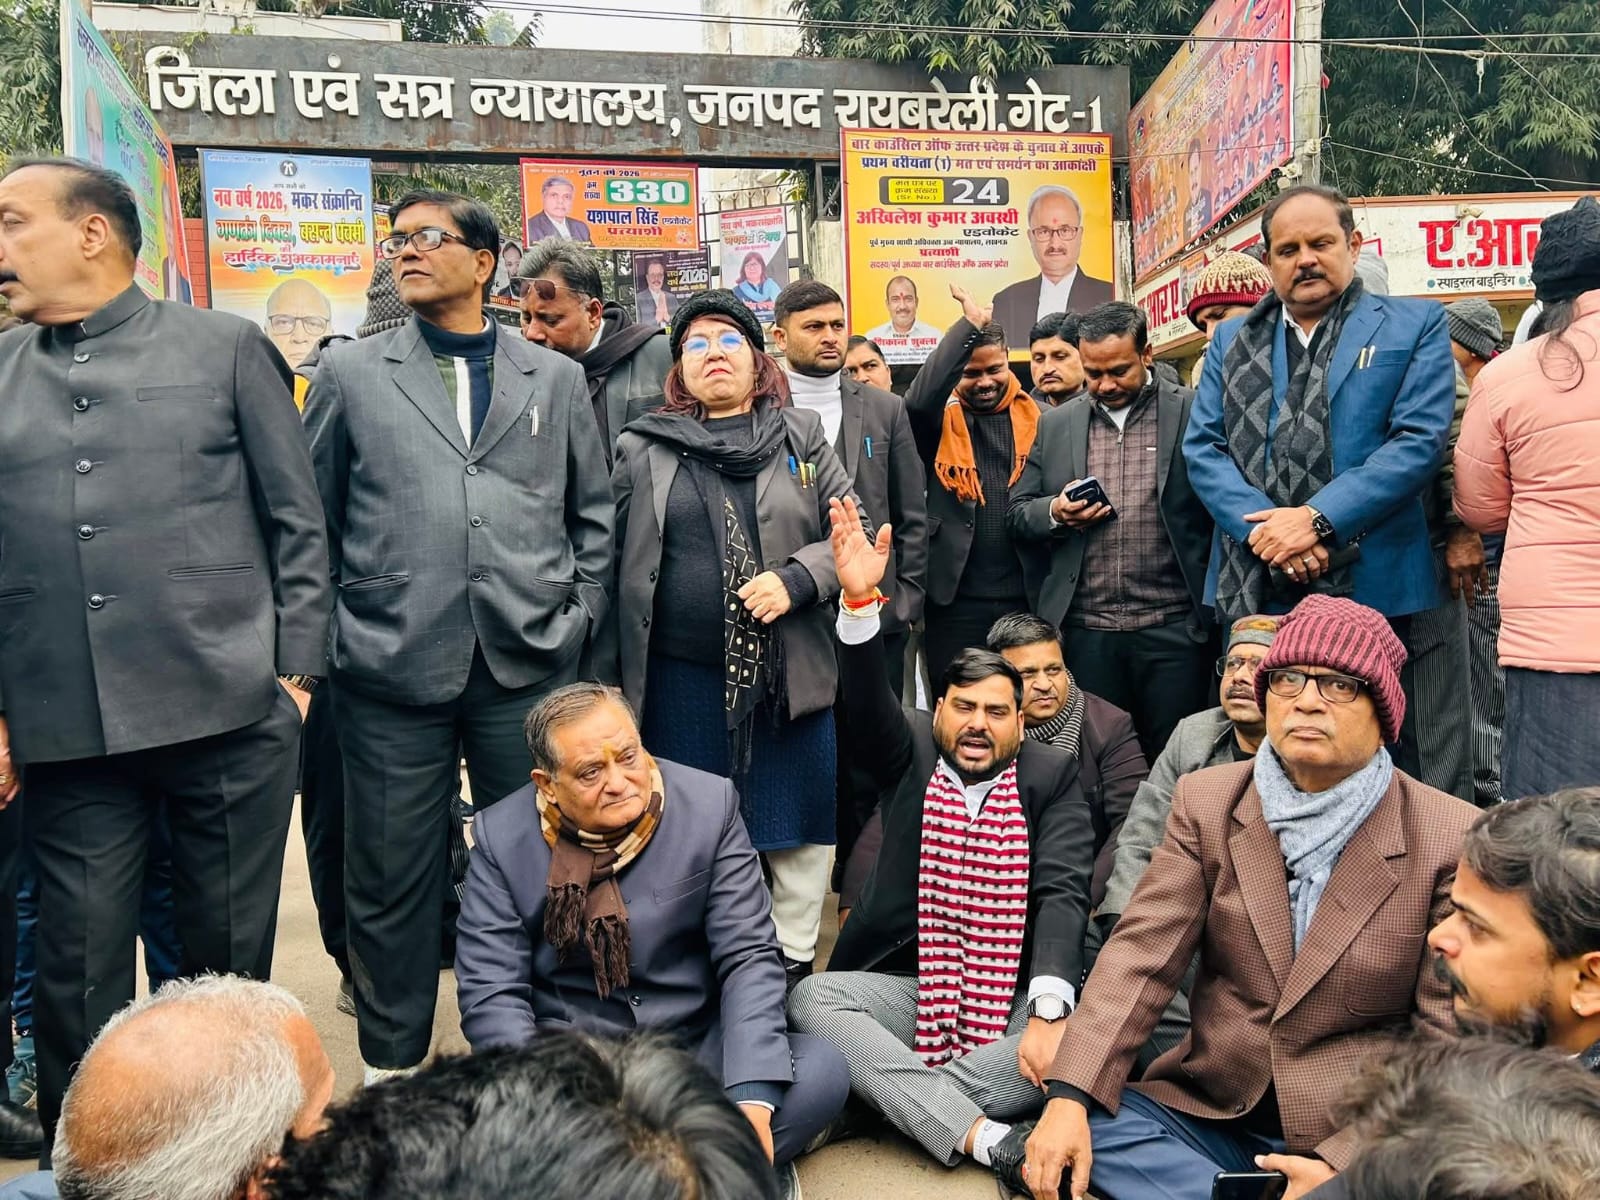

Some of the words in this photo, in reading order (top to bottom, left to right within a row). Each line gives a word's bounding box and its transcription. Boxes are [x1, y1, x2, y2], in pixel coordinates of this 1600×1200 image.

[145, 45, 277, 116] जिला
[289, 53, 361, 118] एवं
[373, 73, 455, 119] सत्र
[683, 84, 824, 128] जनपद
[852, 138, 870, 150] बार
[984, 139, 1009, 152] प्रदेश
[1013, 140, 1024, 152] के
[1029, 142, 1056, 156] चुनाव
[1060, 140, 1069, 153] में
[1072, 142, 1104, 154] आपके
[862, 157, 888, 168] प्रथम
[892, 155, 931, 169] वरीयता
[934, 155, 951, 171] (1)
[956, 159, 972, 169] मत
[976, 157, 992, 169] एवं
[996, 157, 1031, 170] समर्थन
[1035, 160, 1049, 170] का
[214, 189, 232, 207] नव
[235, 184, 252, 207] वर्ष
[291, 191, 318, 209] मकर
[610, 180, 685, 203] 330
[952, 179, 1000, 204] 24
[586, 209, 632, 224] यशपाल
[636, 207, 659, 225] सिंह
[856, 208, 922, 225] अखिलेश
[928, 210, 966, 228] कुमार
[971, 208, 1018, 225] अवस्थी
[335, 217, 365, 244] पंचमी
[607, 226, 663, 236] प्रत्याशी
[963, 226, 1019, 237] एडवोकेट
[919, 247, 959, 256] प्रत्याशी
[679, 268, 708, 284] 2026
